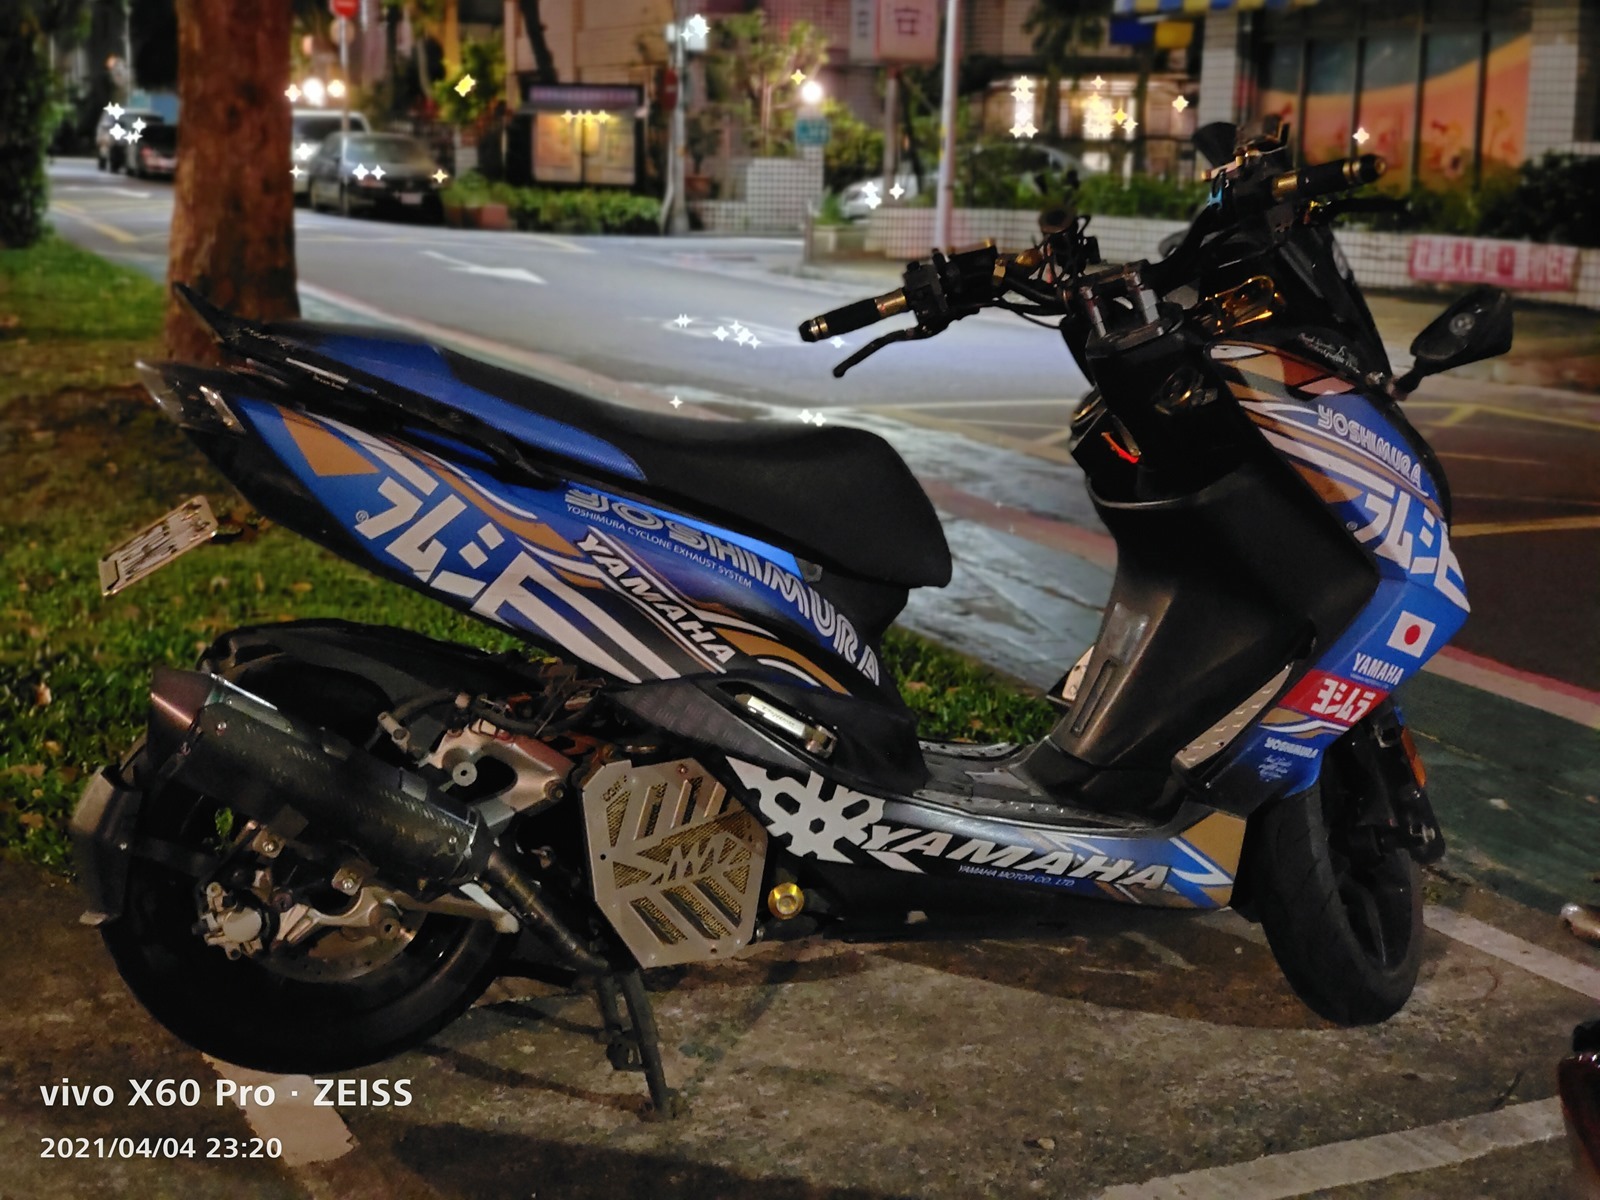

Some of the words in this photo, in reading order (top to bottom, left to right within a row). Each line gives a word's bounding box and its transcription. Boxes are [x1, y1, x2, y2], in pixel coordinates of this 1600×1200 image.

[1317, 404, 1423, 491] YOSHIMURA
[565, 489, 880, 686] YOSHIMURA
[566, 503, 626, 532] YOSHIMURA
[627, 526, 673, 550] CYCLONE
[673, 544, 717, 571] EXHAUST
[718, 564, 752, 589] SYSTEM
[577, 533, 736, 665] YAMAHA
[1352, 652, 1404, 686] YAMAHA
[860, 825, 1172, 890] YAMAHA
[958, 864, 998, 877] YAMAHA
[997, 870, 1035, 882] MOTOR
